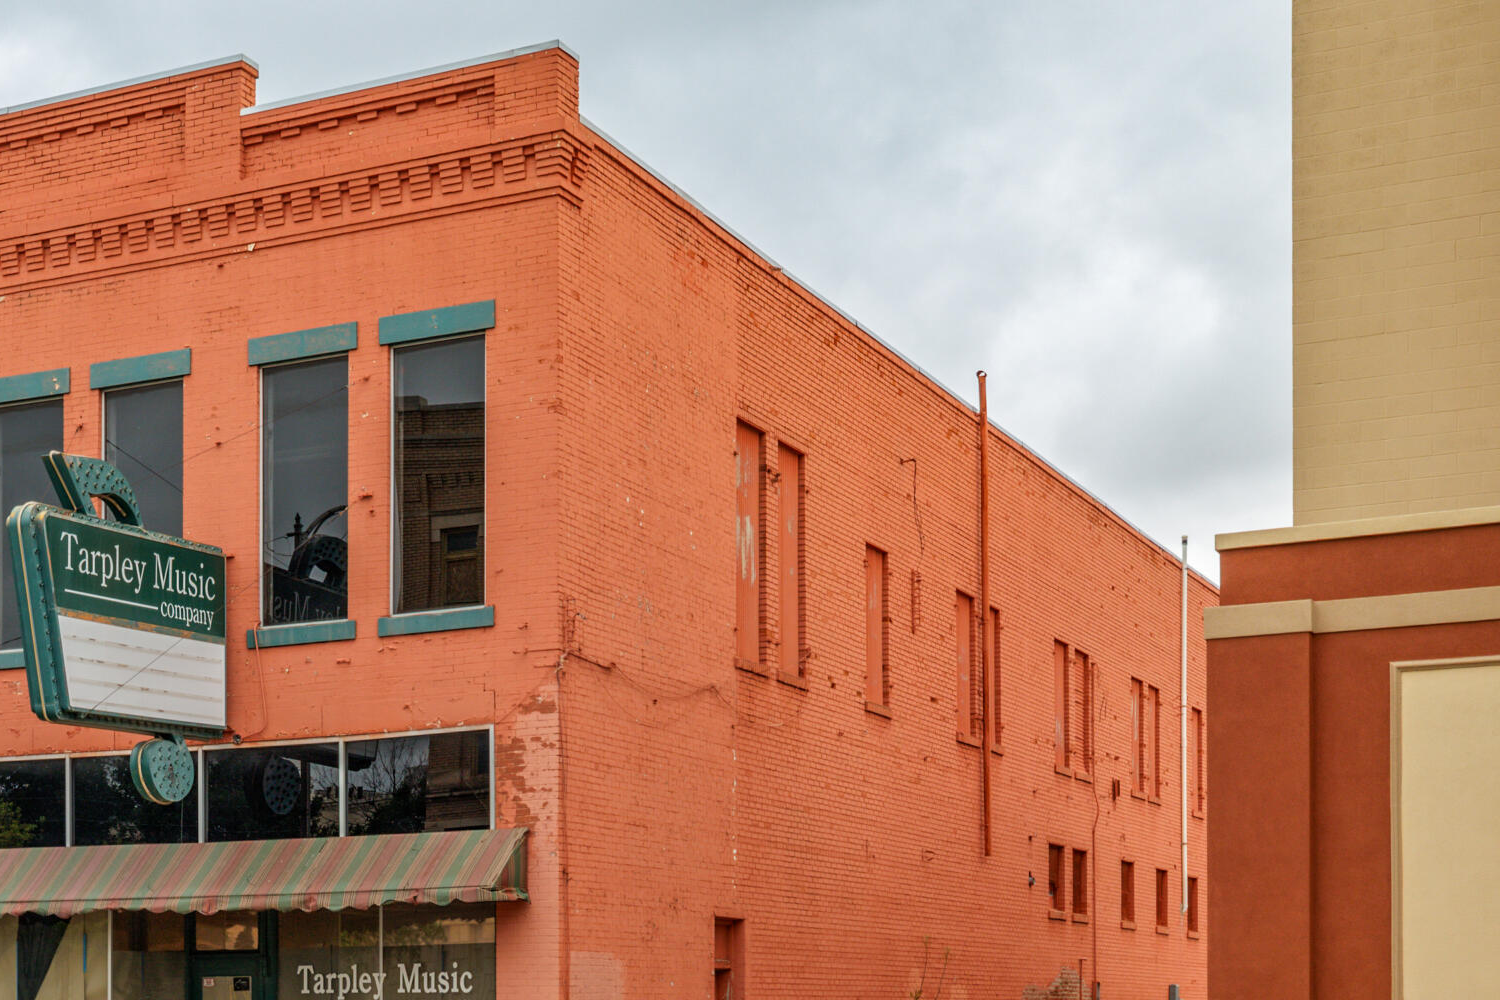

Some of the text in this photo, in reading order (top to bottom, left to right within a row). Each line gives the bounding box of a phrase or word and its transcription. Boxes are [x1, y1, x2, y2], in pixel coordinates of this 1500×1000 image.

[60, 531, 216, 601] Tarpley Music
[160, 601, 215, 631] company
[296, 961, 473, 1000] Tarpley Music
